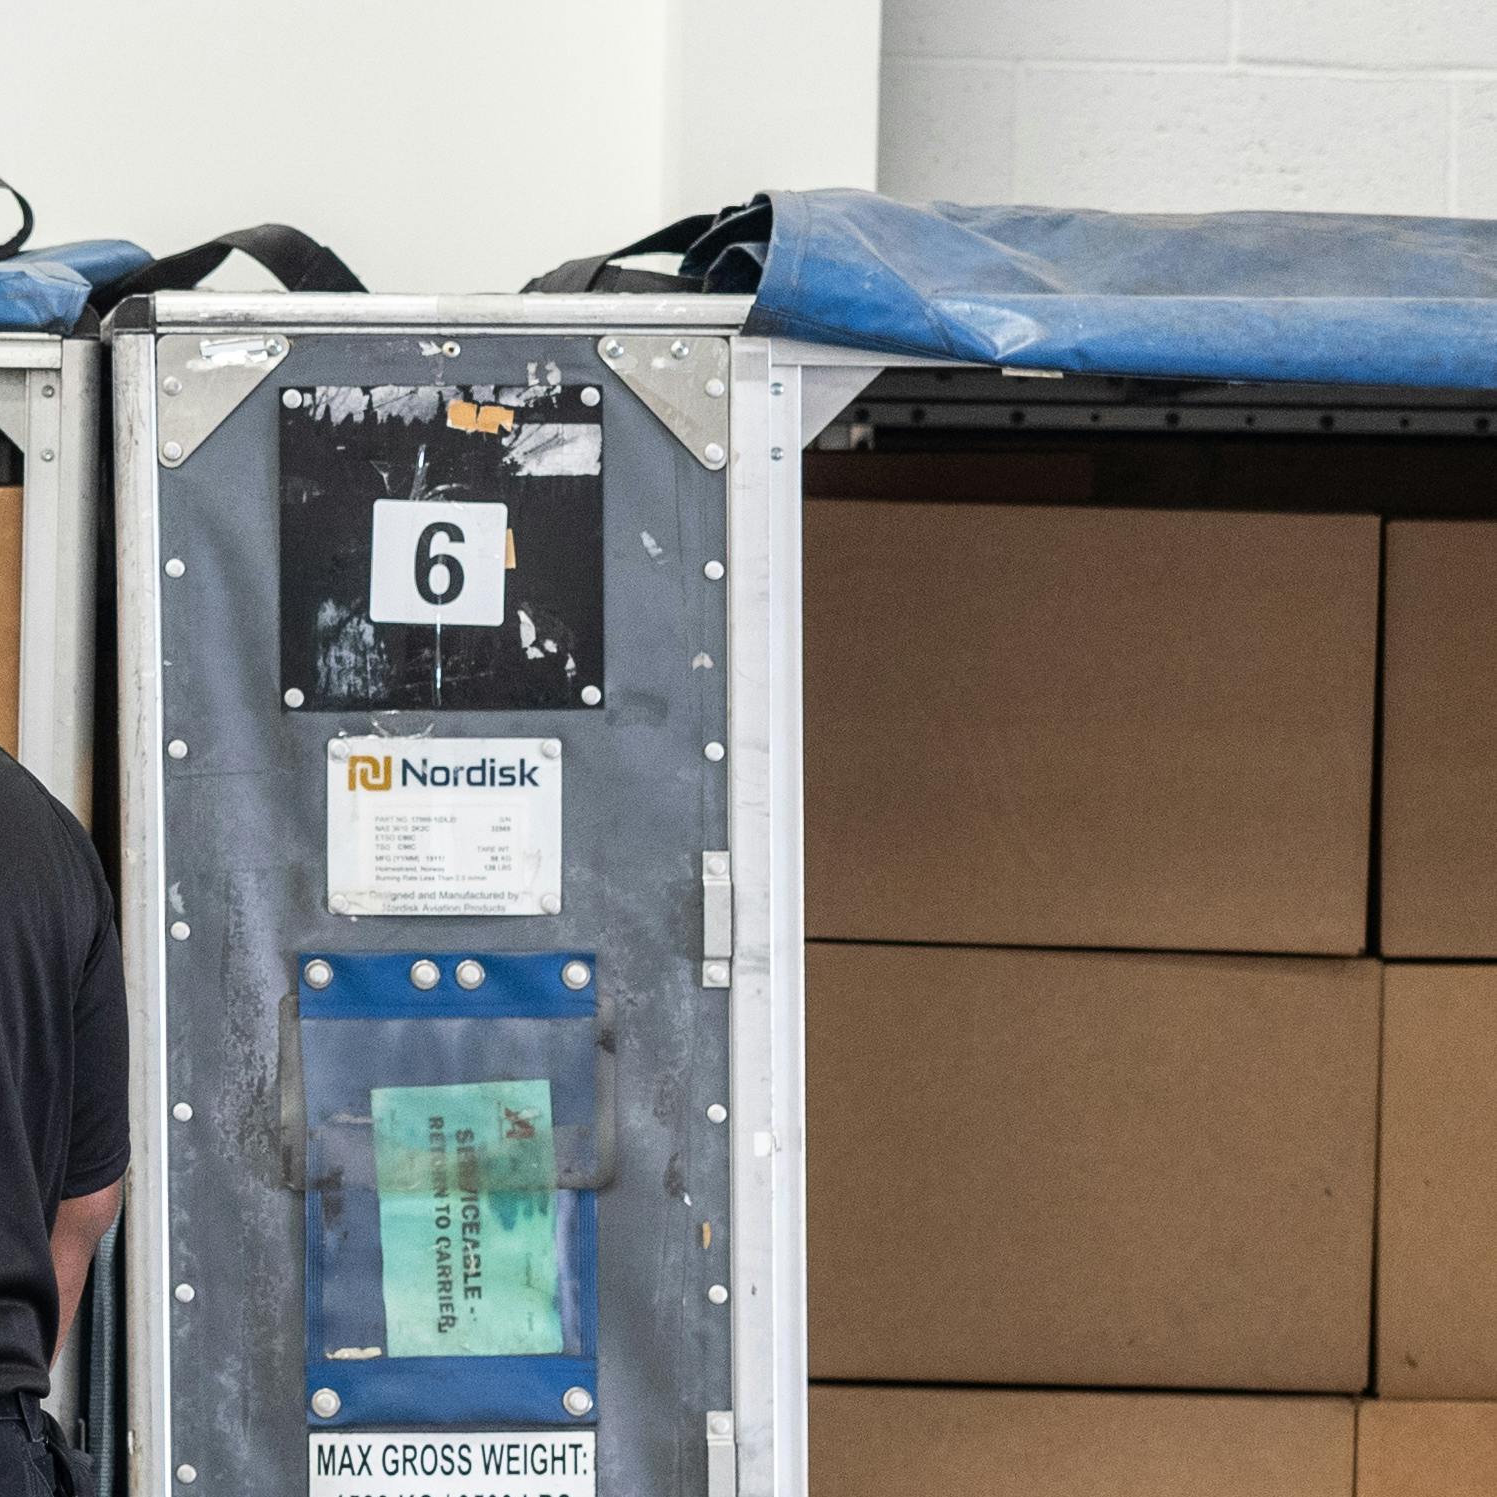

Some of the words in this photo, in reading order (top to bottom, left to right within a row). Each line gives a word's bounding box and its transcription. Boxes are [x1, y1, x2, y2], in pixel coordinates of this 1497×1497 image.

[413, 521, 465, 606] 6
[401, 757, 541, 788] Nordisk
[417, 890, 436, 901] and
[438, 890, 506, 902] Manufactured
[507, 890, 519, 903] by
[421, 903, 462, 914] Aviation
[463, 903, 507, 915] Products
[435, 1204, 451, 1231] TO
[317, 1444, 373, 1476] MAX
[382, 1443, 472, 1476] GROSS
[481, 1444, 588, 1475] WEIGHT:
